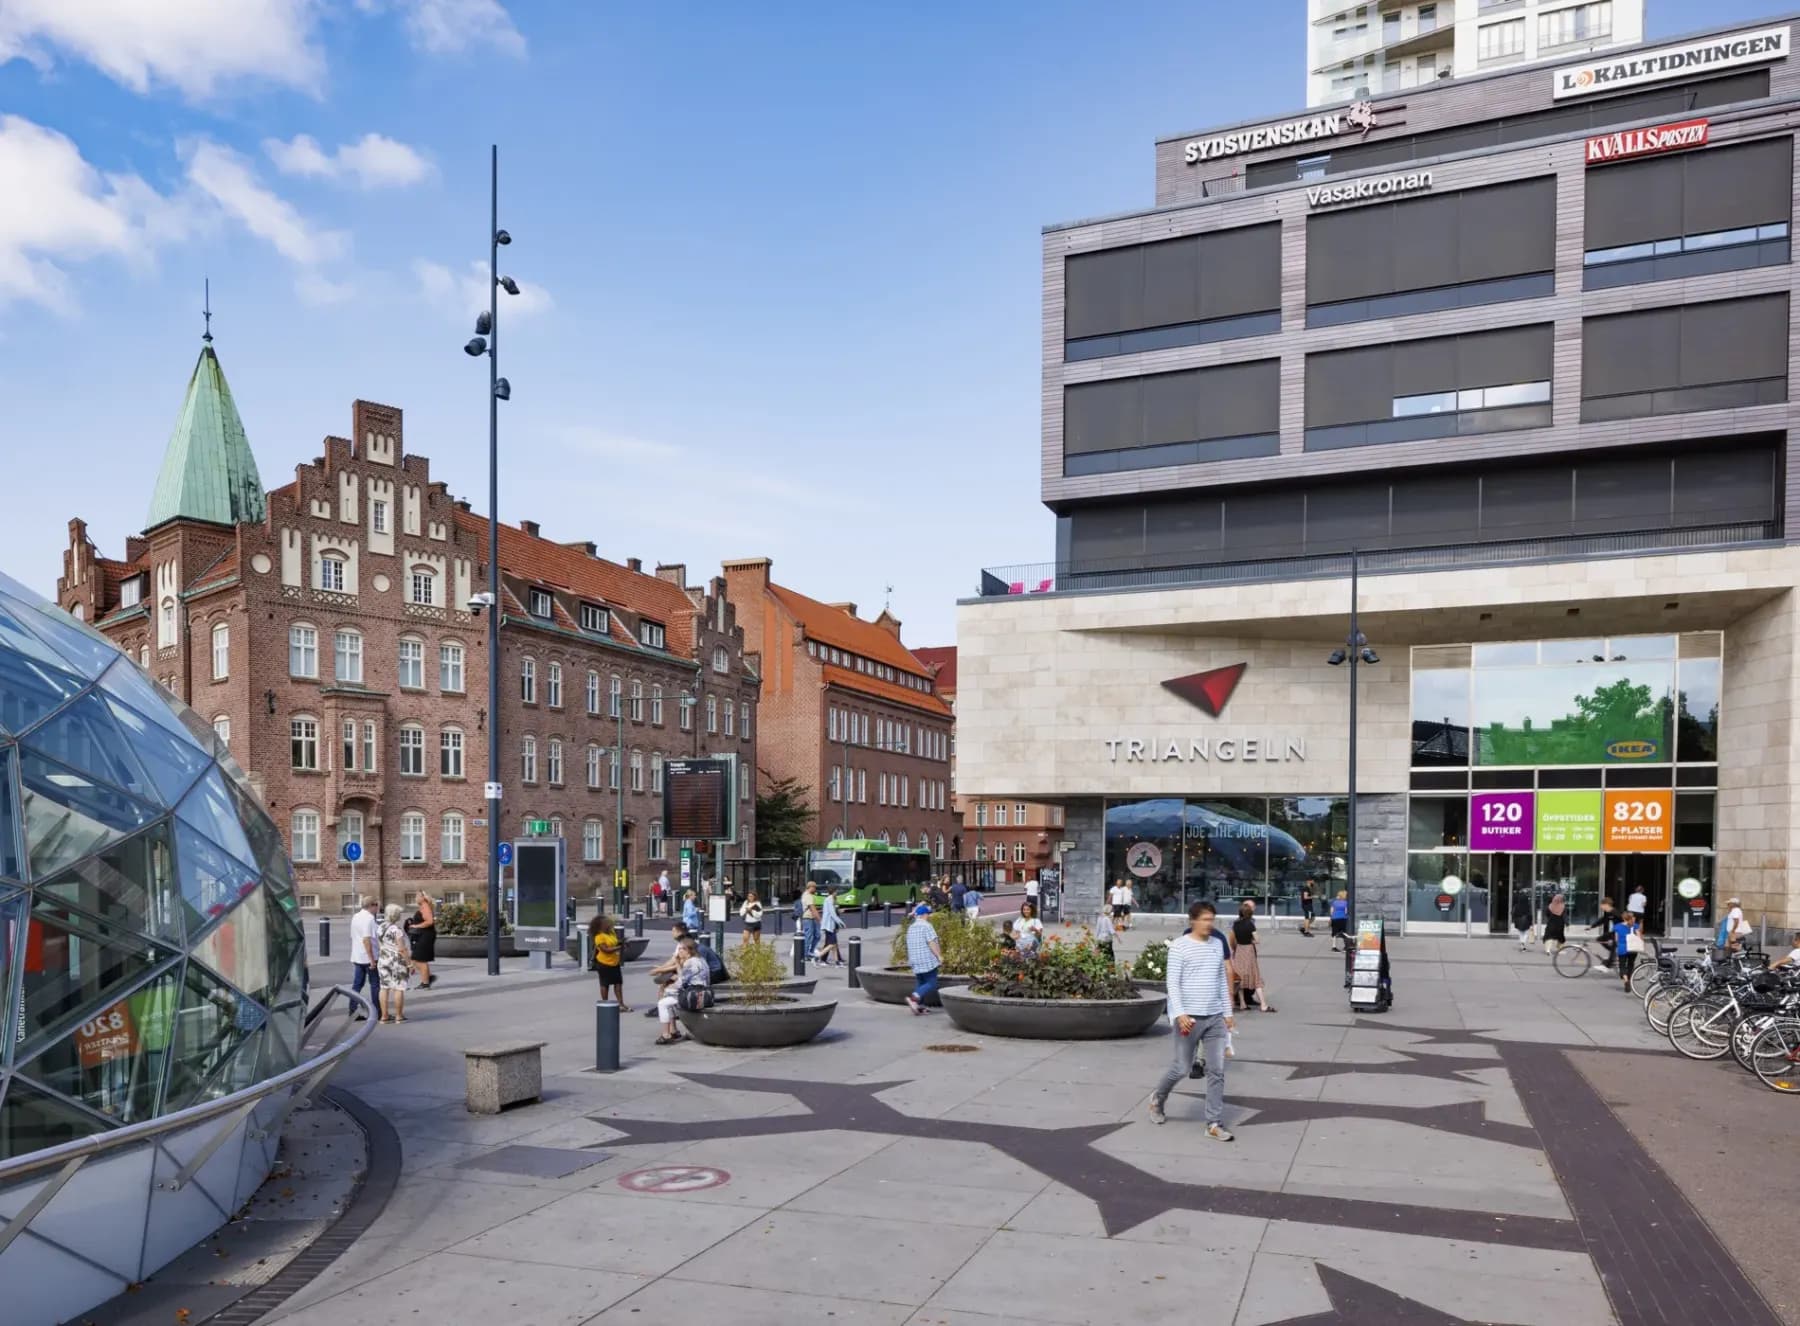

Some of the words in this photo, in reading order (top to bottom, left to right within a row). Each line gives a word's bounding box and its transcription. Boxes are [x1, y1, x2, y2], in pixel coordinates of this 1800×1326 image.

[1562, 34, 1782, 90] LOKALTIDNINGEN
[1184, 114, 1341, 164] SYDSVENSKAN
[1306, 171, 1433, 207] Vasakronan
[1105, 737, 1305, 763] TRIANGELN
[1610, 744, 1652, 753] IKEA
[1481, 803, 1522, 821] 120
[1613, 801, 1662, 821] 820
[1187, 824, 1206, 838] JOE
[1236, 824, 1268, 839] JUICE
[1481, 827, 1522, 835] BUTIKER
[1611, 826, 1663, 835] P-PLATSER
